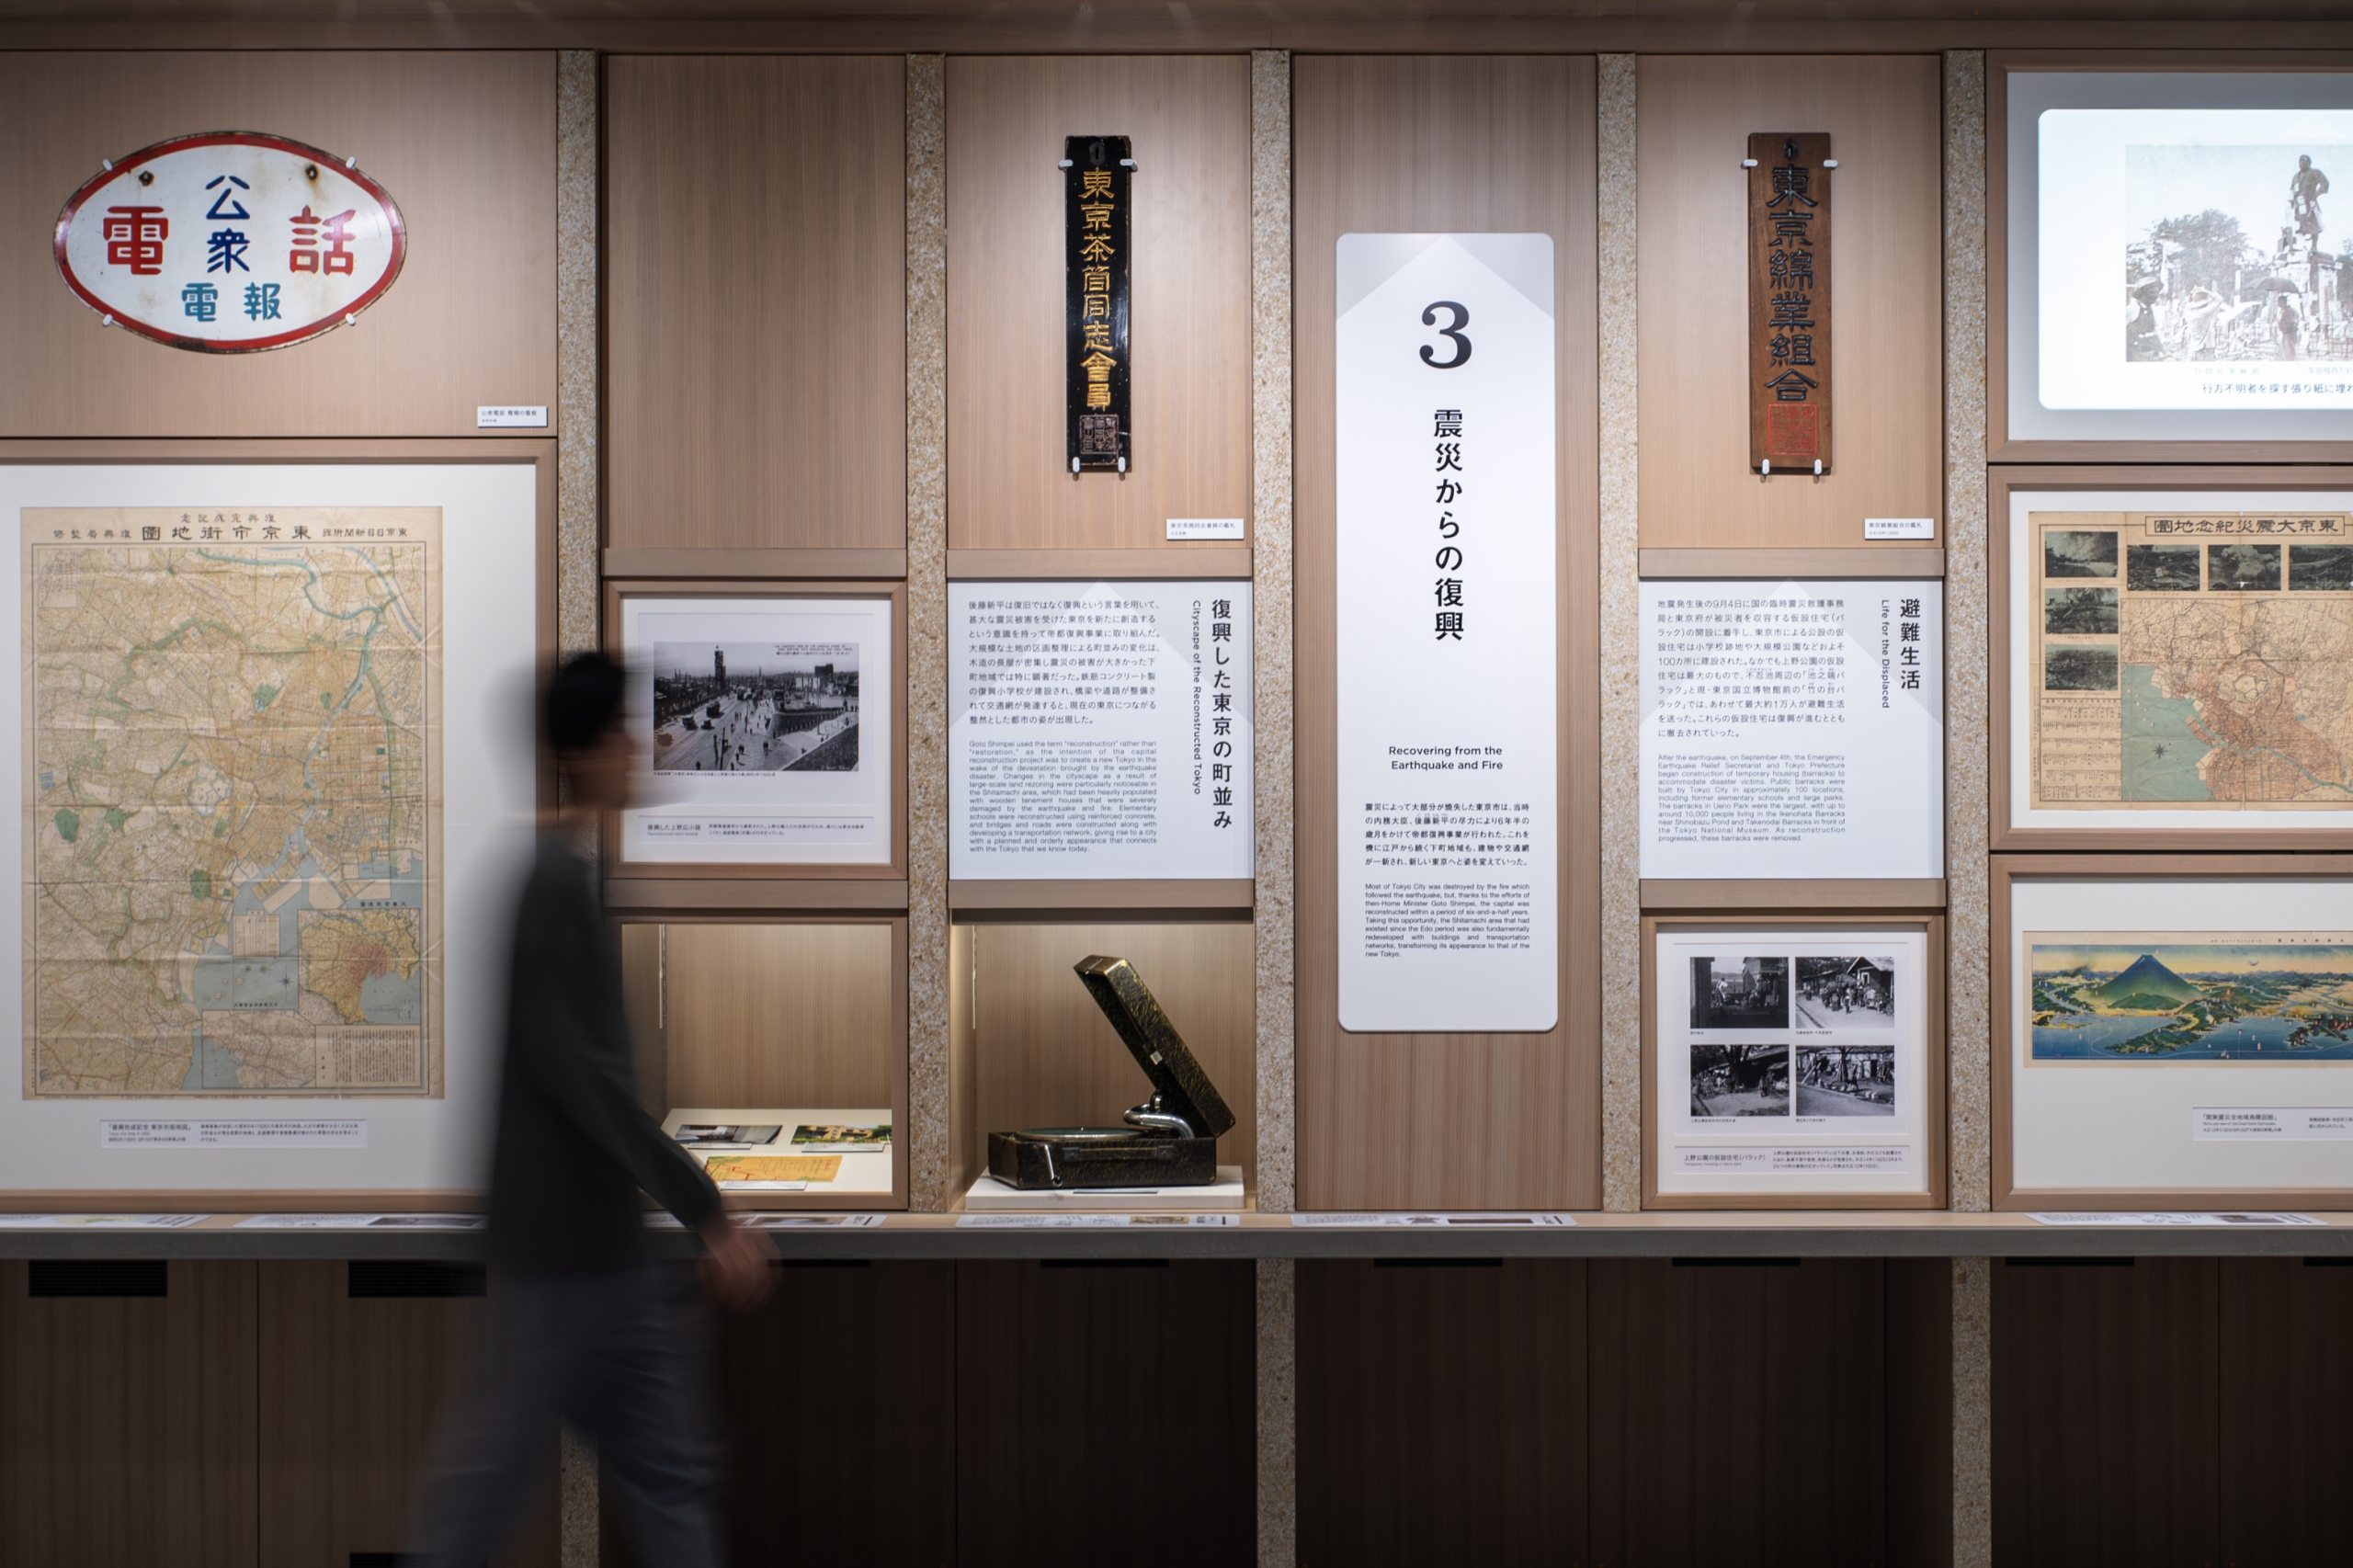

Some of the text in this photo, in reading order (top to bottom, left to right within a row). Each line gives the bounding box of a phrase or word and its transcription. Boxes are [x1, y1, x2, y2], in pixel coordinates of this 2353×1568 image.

[205, 175, 250, 274] 公衆
[1765, 164, 1819, 402] 東京綿業組合
[181, 282, 281, 322] 電報
[1419, 301, 1472, 369] 3
[1434, 409, 1464, 641] 震災からの復興
[1881, 599, 1890, 708] Life for the Displaced
[1900, 598, 1921, 690] 避難生活
[1191, 600, 1202, 795] Cityscape of the Reconstructed Tokyo
[1211, 599, 1233, 829] 復興した東京の町並み
[1658, 728, 1740, 738] に撤去されていった。
[1115, 756, 1136, 765] Tokyo
[1389, 746, 1502, 757] Recovering from the
[1391, 760, 1503, 771] Earthquake and Fire
[1658, 770, 1679, 778] began
[1785, 762, 1805, 770] Tokyo
[999, 845, 1020, 853] Tokyo
[1068, 845, 1089, 853] today.
[1392, 883, 1412, 891] Tokyo
[1413, 883, 1426, 891] City
[1436, 908, 1457, 917] period
